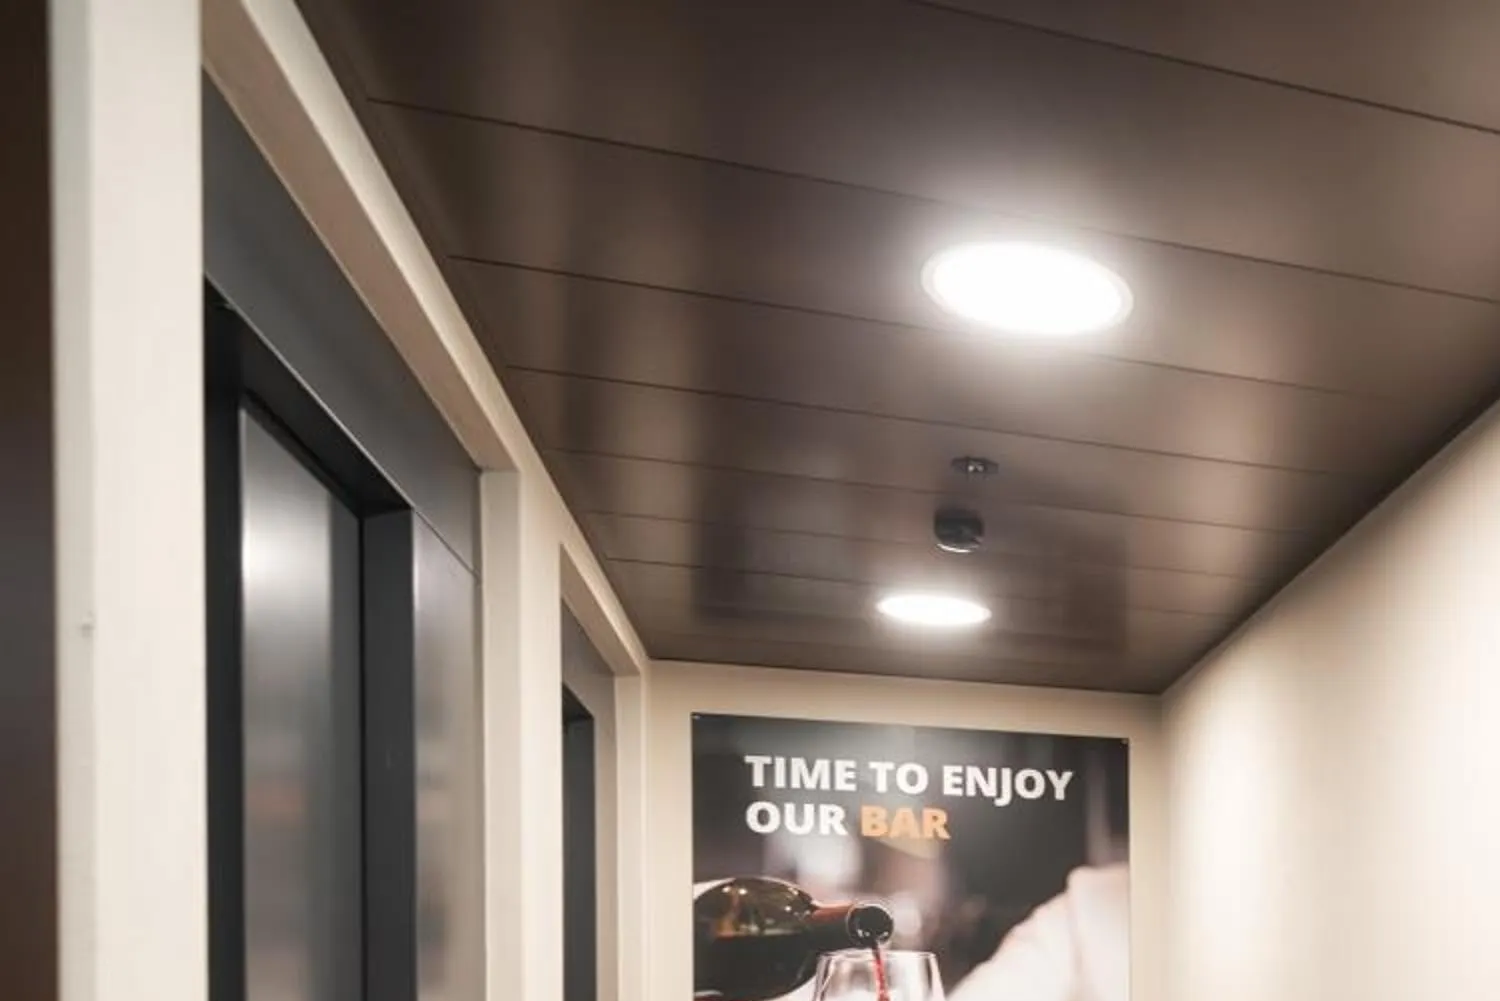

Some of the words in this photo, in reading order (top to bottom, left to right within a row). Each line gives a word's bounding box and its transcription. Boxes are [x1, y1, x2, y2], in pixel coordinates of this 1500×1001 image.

[744, 755, 857, 791] TIME
[869, 761, 929, 795] TO
[942, 764, 1073, 806] ENJOY
[745, 801, 848, 836] OUR
[860, 804, 951, 840] BAR
